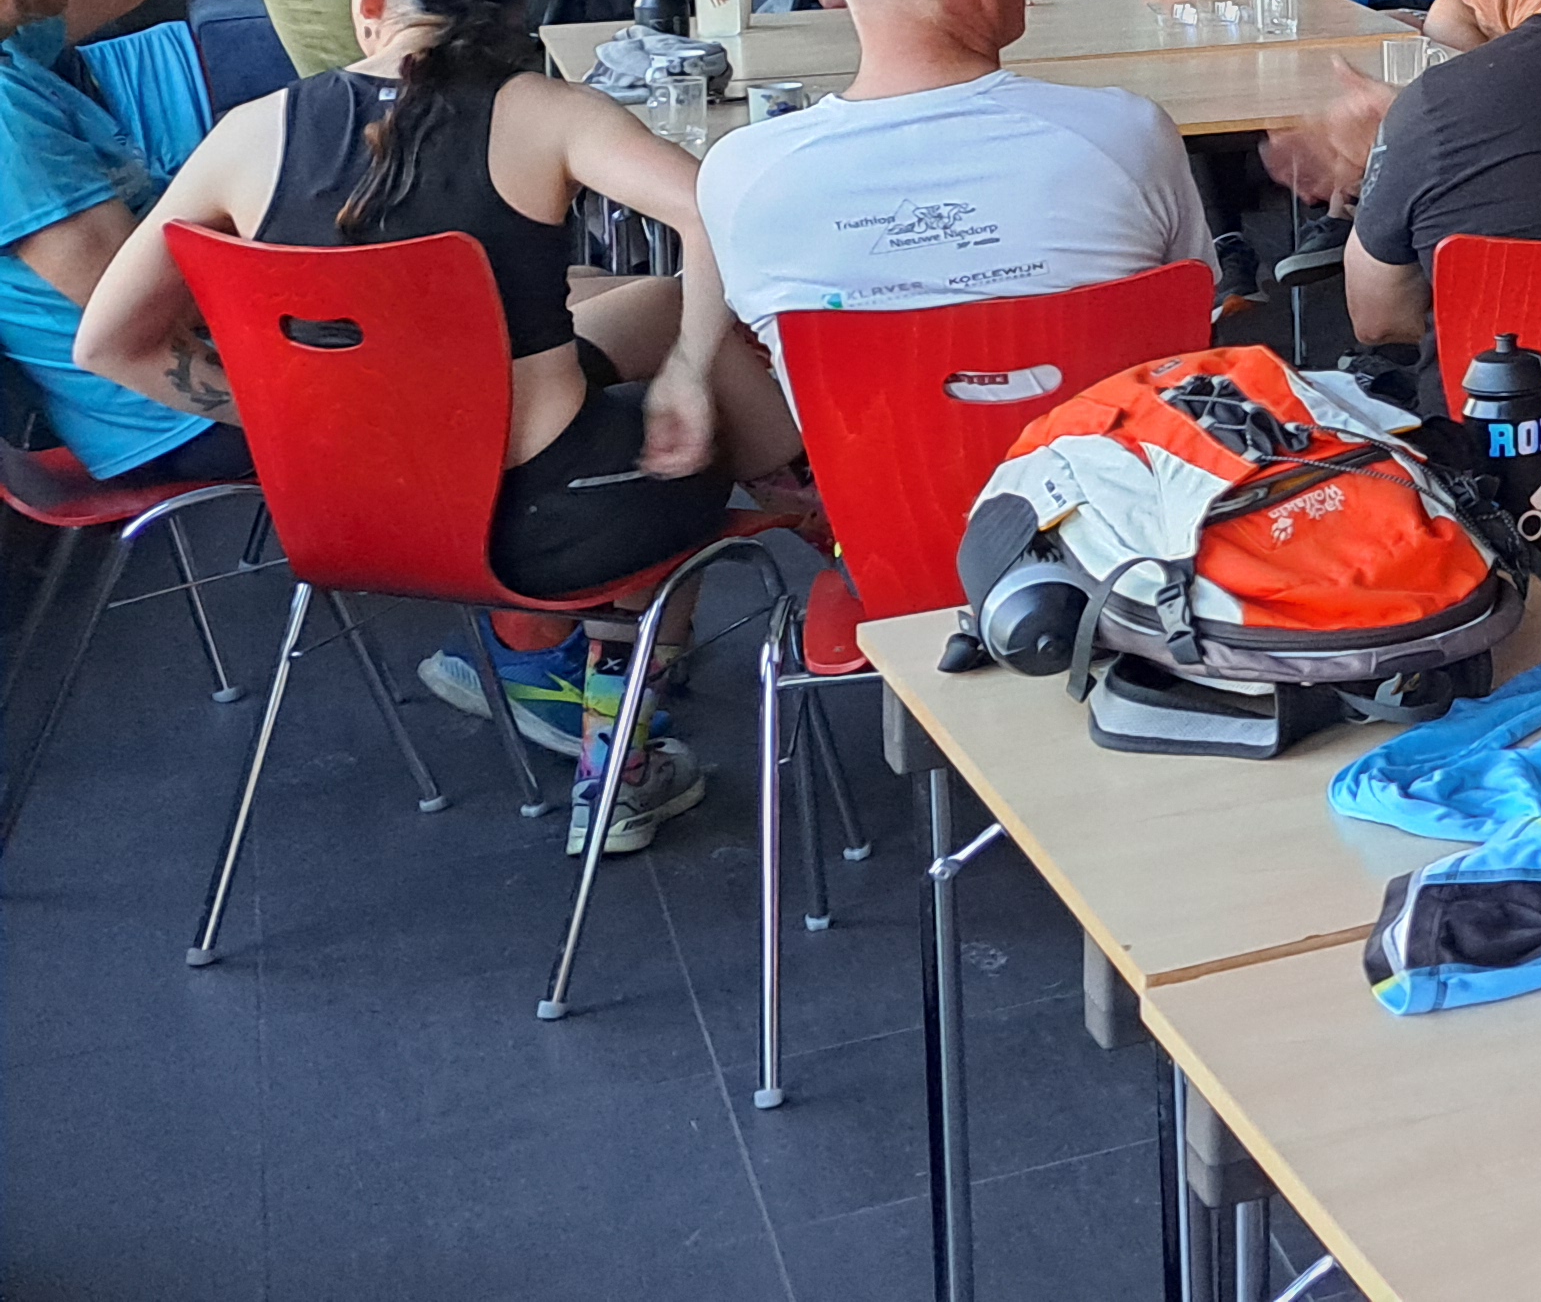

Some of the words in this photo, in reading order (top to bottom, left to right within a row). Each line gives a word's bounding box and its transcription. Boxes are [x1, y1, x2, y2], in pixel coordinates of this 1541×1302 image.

[834, 215, 896, 232] Triathlon
[889, 234, 941, 249] Nieuwe
[943, 223, 999, 242] Niedorp
[948, 261, 1044, 286] KOELEWIJN
[1306, 494, 1345, 520] Jack
